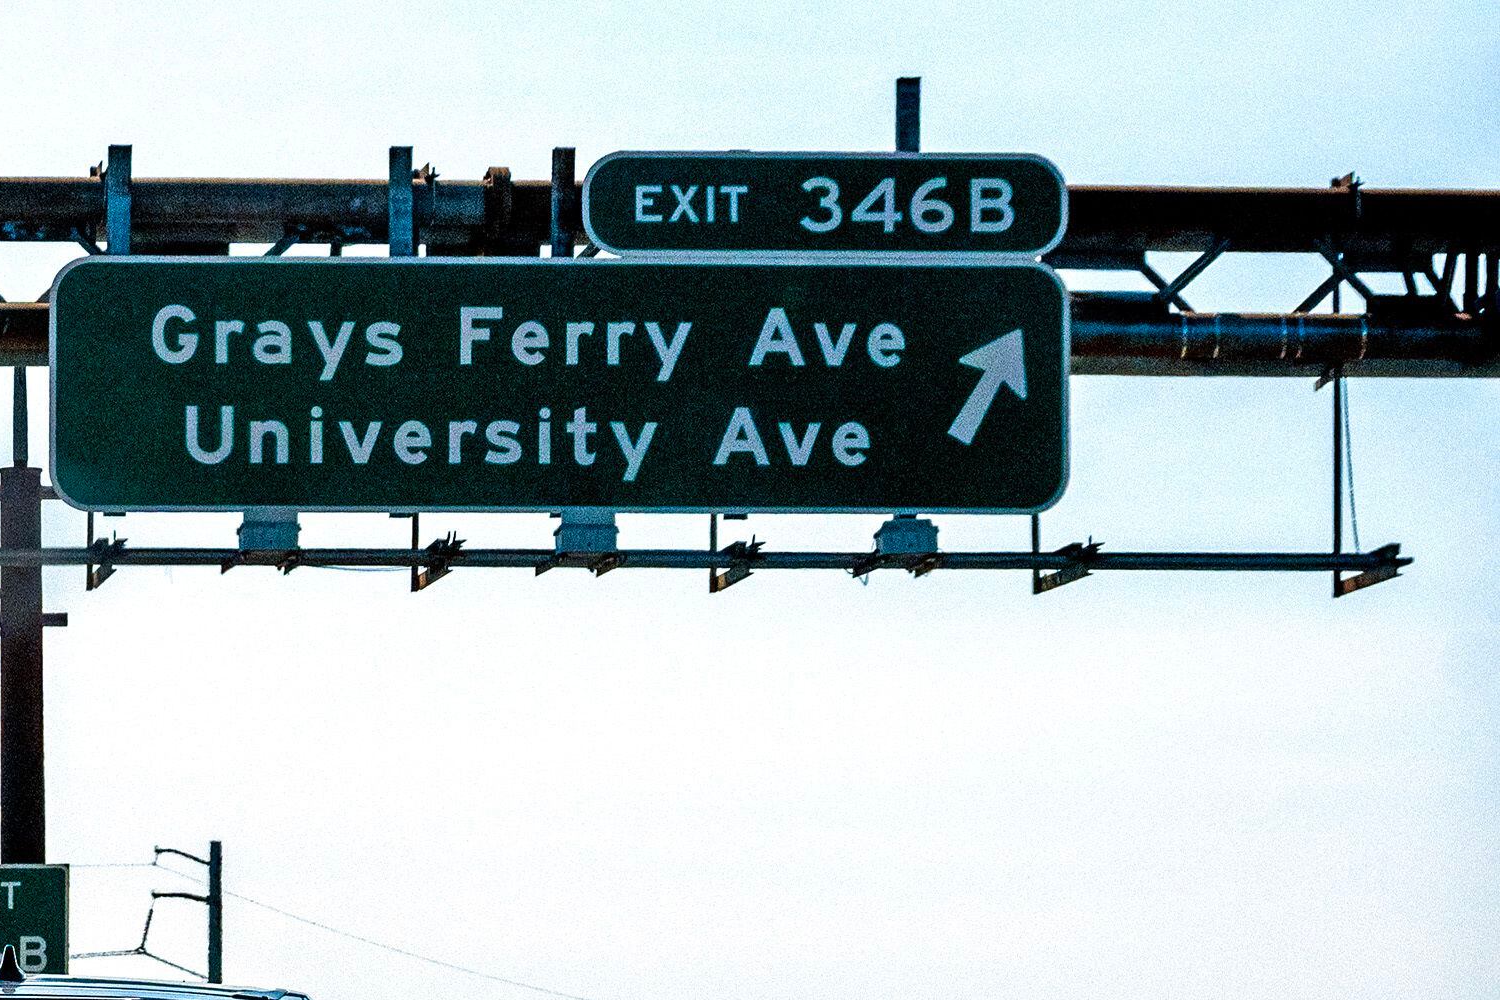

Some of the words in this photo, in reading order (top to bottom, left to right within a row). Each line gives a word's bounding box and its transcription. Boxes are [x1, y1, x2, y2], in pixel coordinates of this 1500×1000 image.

[636, 186, 747, 222] EXIT
[801, 177, 1014, 233] 346B
[152, 304, 403, 381] Grays
[459, 306, 692, 382] Ferry
[749, 307, 906, 367] Ave
[185, 405, 656, 481] University
[713, 406, 871, 466] Ave
